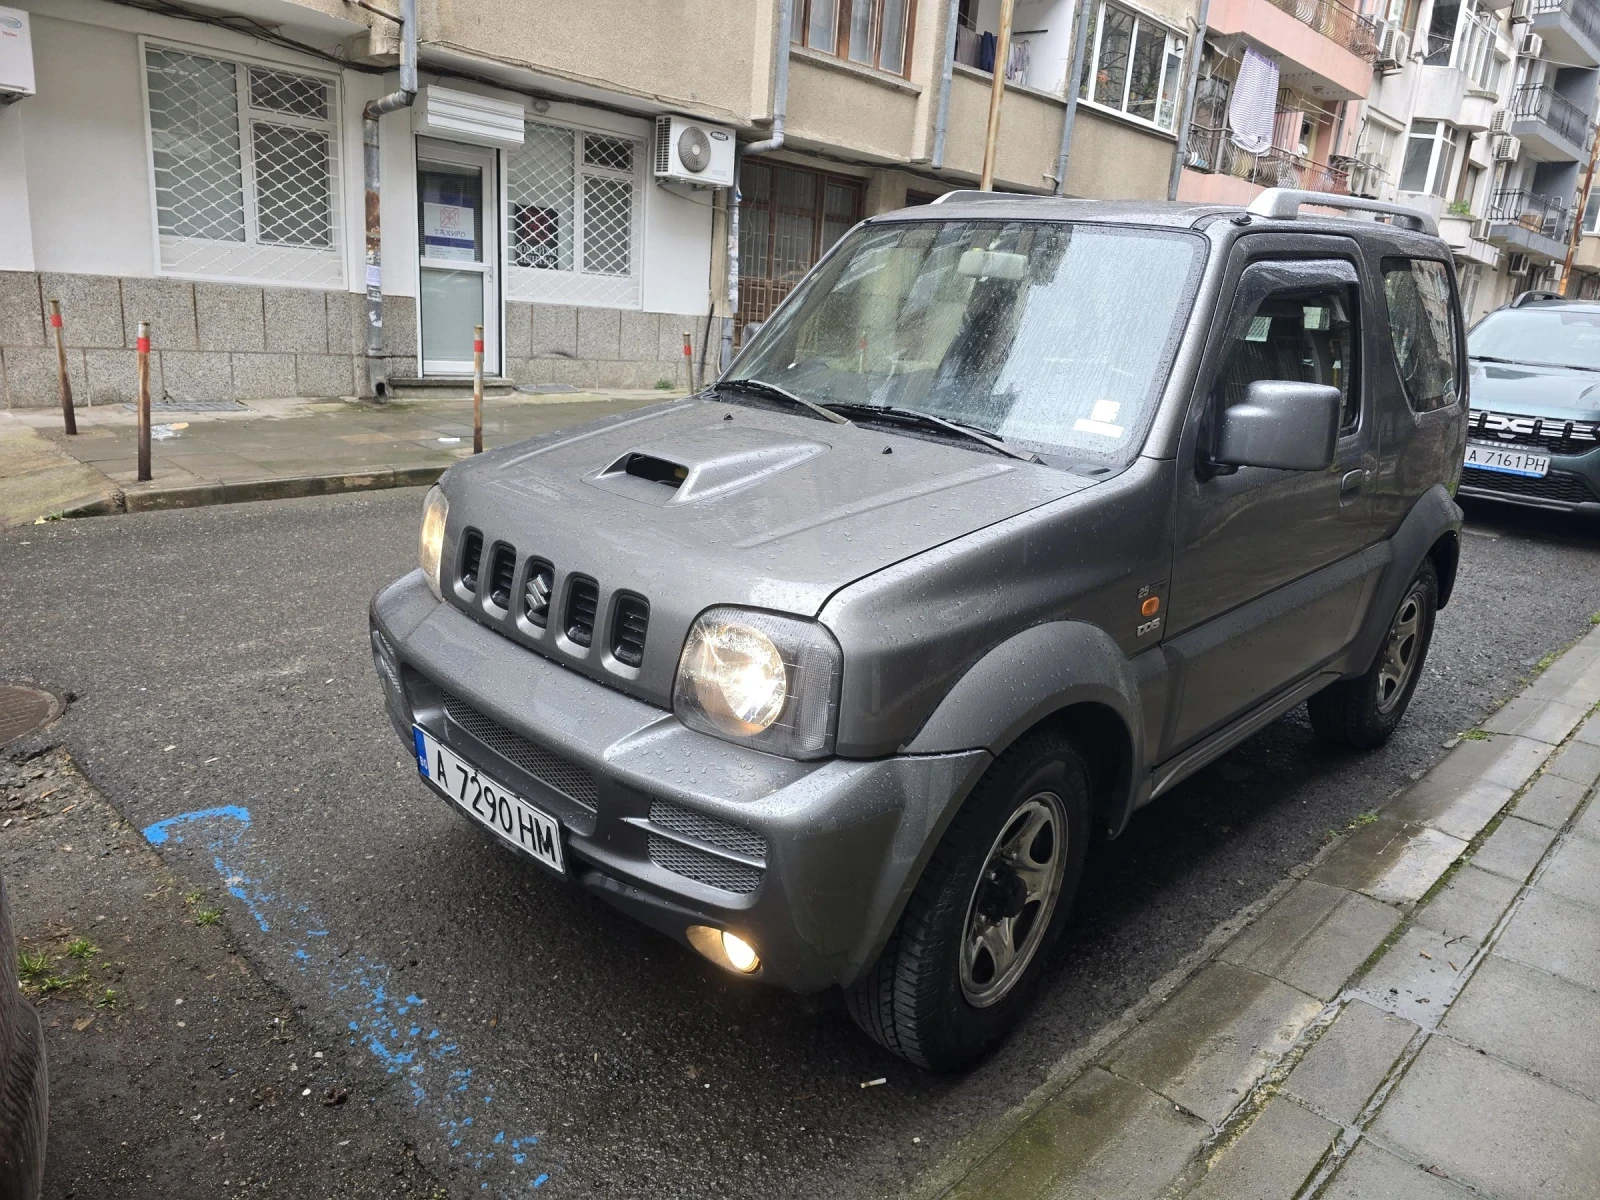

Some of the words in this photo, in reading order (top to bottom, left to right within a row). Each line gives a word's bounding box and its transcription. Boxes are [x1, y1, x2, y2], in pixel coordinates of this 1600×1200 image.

[1468, 449, 1477, 462] A
[437, 750, 448, 788] A
[456, 763, 513, 834] 7290
[517, 805, 557, 863] HM
